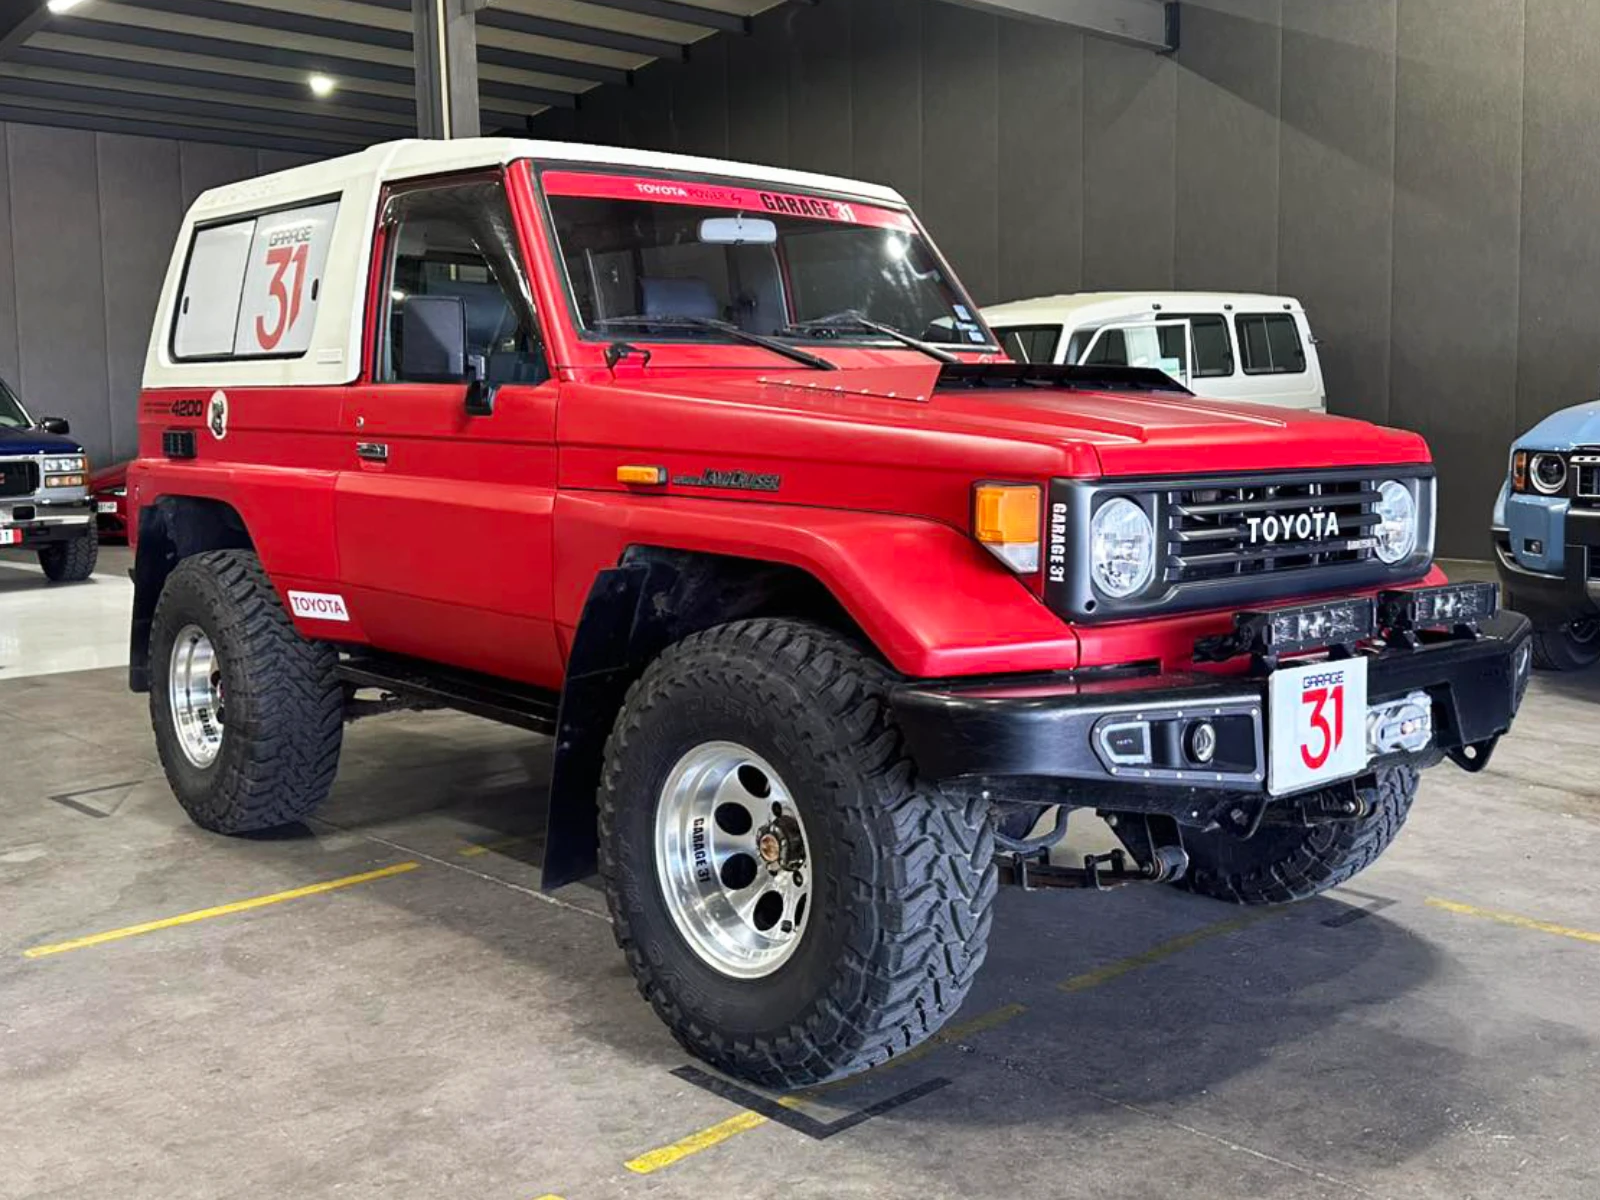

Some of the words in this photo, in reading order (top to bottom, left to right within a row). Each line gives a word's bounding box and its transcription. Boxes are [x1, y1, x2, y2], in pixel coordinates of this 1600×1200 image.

[635, 183, 687, 197] TOYOTA
[760, 193, 835, 218] GARAGE
[833, 201, 857, 222] 31
[269, 225, 313, 246] GARAGE
[256, 244, 309, 350] 31
[171, 400, 203, 416] 4200
[1050, 503, 1067, 563] GARAGE
[1246, 511, 1339, 543] TOYOTA
[1049, 566, 1065, 582] 31
[292, 596, 344, 615] TOYOTA
[1303, 671, 1344, 689] GARAGE
[1300, 685, 1344, 769] 31
[693, 818, 707, 867] GARAGE
[698, 868, 710, 882] 31
